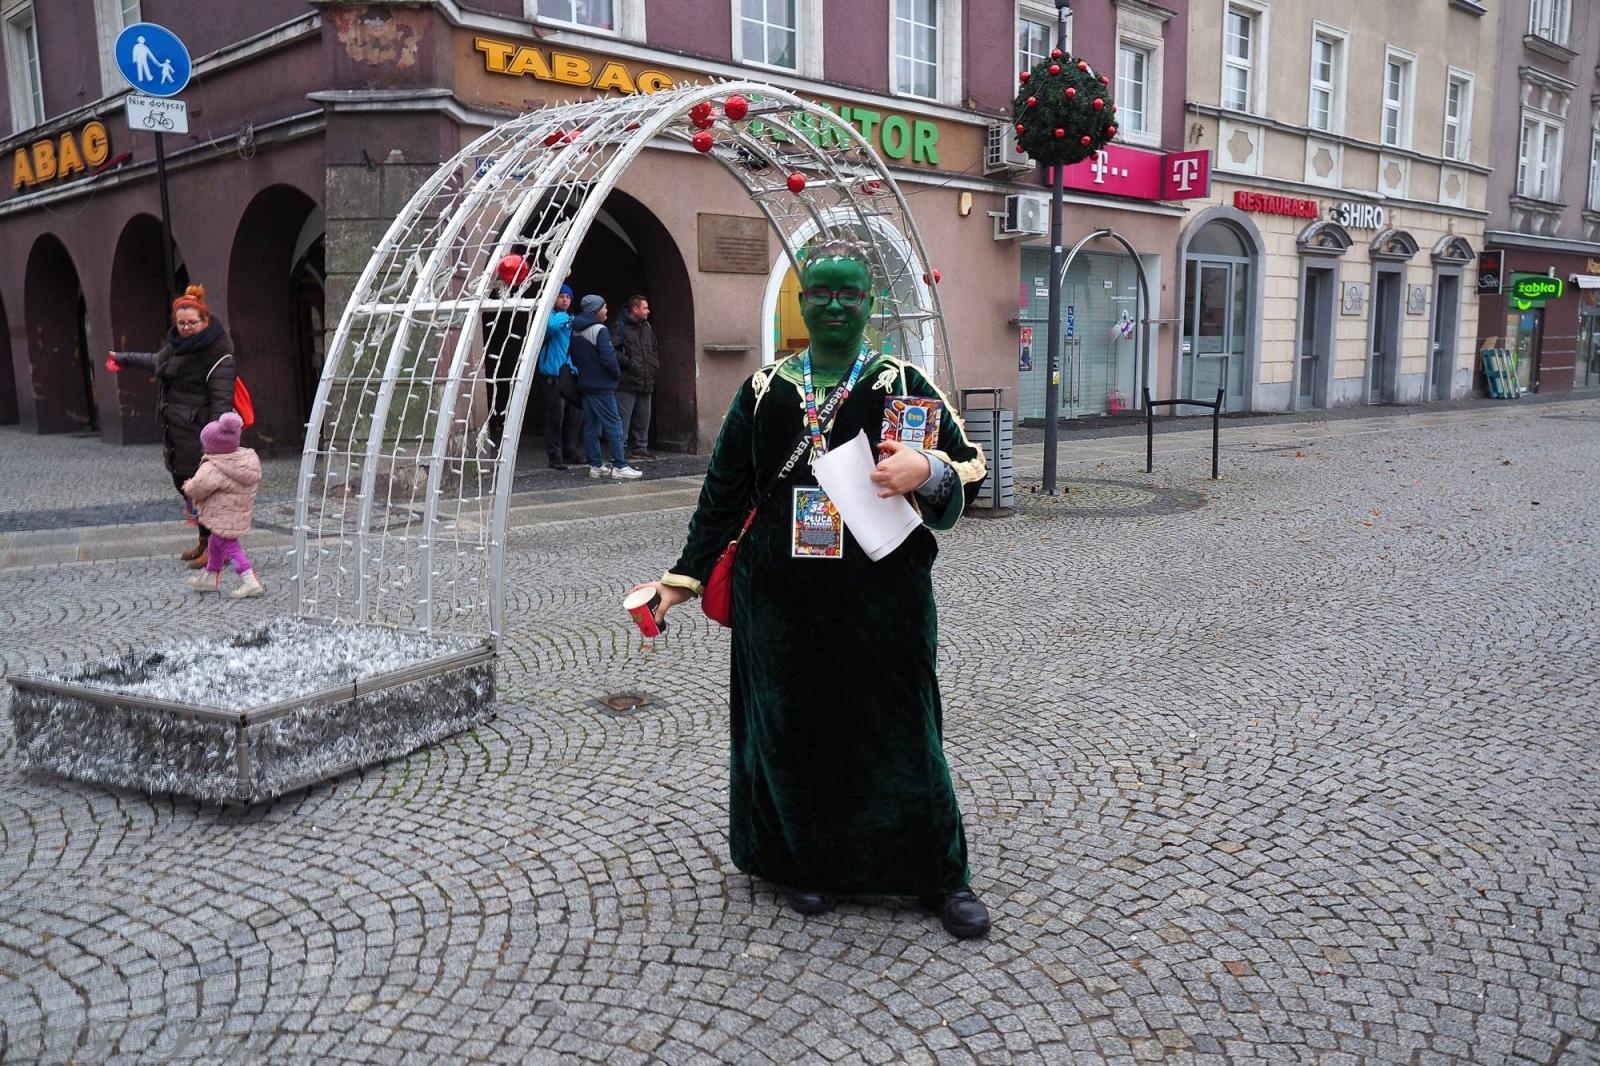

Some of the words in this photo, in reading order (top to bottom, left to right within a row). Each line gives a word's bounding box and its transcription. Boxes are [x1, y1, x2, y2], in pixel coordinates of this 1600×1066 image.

[475, 37, 674, 95] TABAC
[128, 96, 146, 106] Nie
[149, 99, 185, 112] dotyczy
[13, 121, 109, 191] ABAC
[1235, 191, 1320, 221] RESTAURACJA
[1339, 202, 1385, 230] SHIRO
[1518, 282, 1556, 293] żabka
